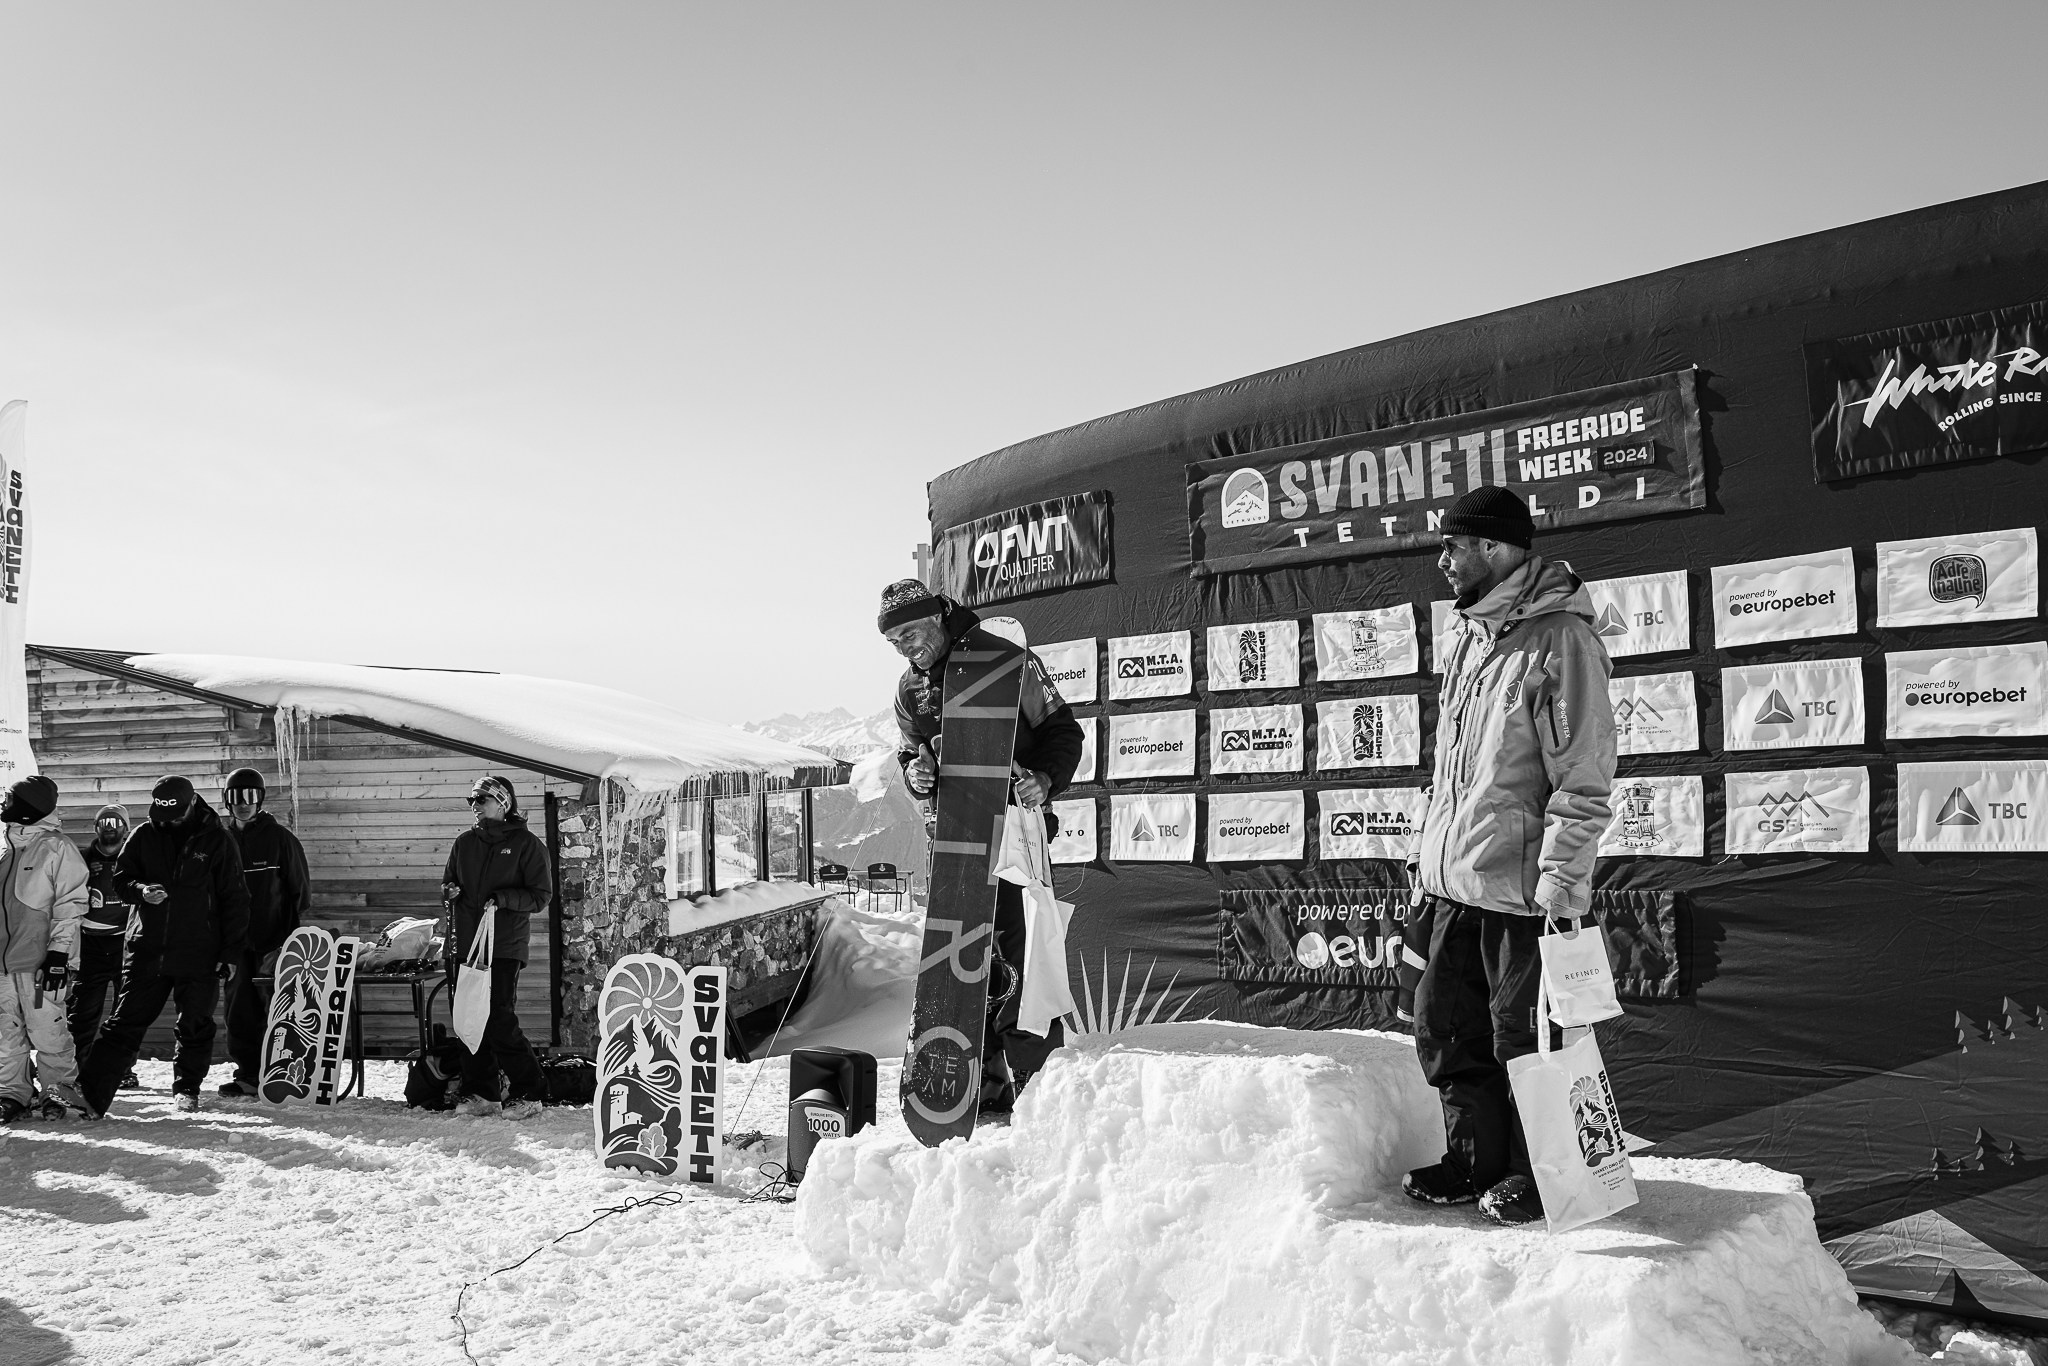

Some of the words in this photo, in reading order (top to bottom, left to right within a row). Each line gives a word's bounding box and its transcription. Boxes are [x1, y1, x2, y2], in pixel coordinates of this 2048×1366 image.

[1937, 397, 1994, 432] ROLLING
[1999, 391, 2043, 404] SINCE
[1517, 407, 1646, 454] FREERIDE
[1518, 448, 1593, 483] WEEK
[1602, 446, 1648, 466] 2024
[1279, 428, 1507, 520] SVANETI
[1293, 476, 1645, 548] TETNLDI
[1000, 514, 1068, 564] FWT
[1000, 554, 1056, 581] QUALIFIER
[1729, 590, 1766, 603] powered
[1767, 588, 1778, 598] by
[1743, 589, 1836, 612] europebet
[1633, 609, 1665, 628] TBC
[1905, 680, 1946, 691] powered
[1948, 679, 1961, 690] by
[1920, 686, 2027, 707] europebet
[1801, 699, 1837, 718] TBC
[1251, 728, 1293, 740] M.T.A.
[1615, 722, 1634, 737] SF
[1127, 740, 1184, 756] europebet
[1366, 811, 1412, 824] M.T.A.
[1988, 802, 2028, 820] TBC
[1219, 817, 1245, 826] powered
[1245, 816, 1253, 825] by
[1228, 822, 1291, 838] europebet
[1757, 818, 1798, 833] GSF
[1157, 824, 1180, 838] TBC
[1296, 898, 1387, 926] powered
[1564, 968, 1600, 981] REFINED
[807, 1117, 841, 1133] 1000
